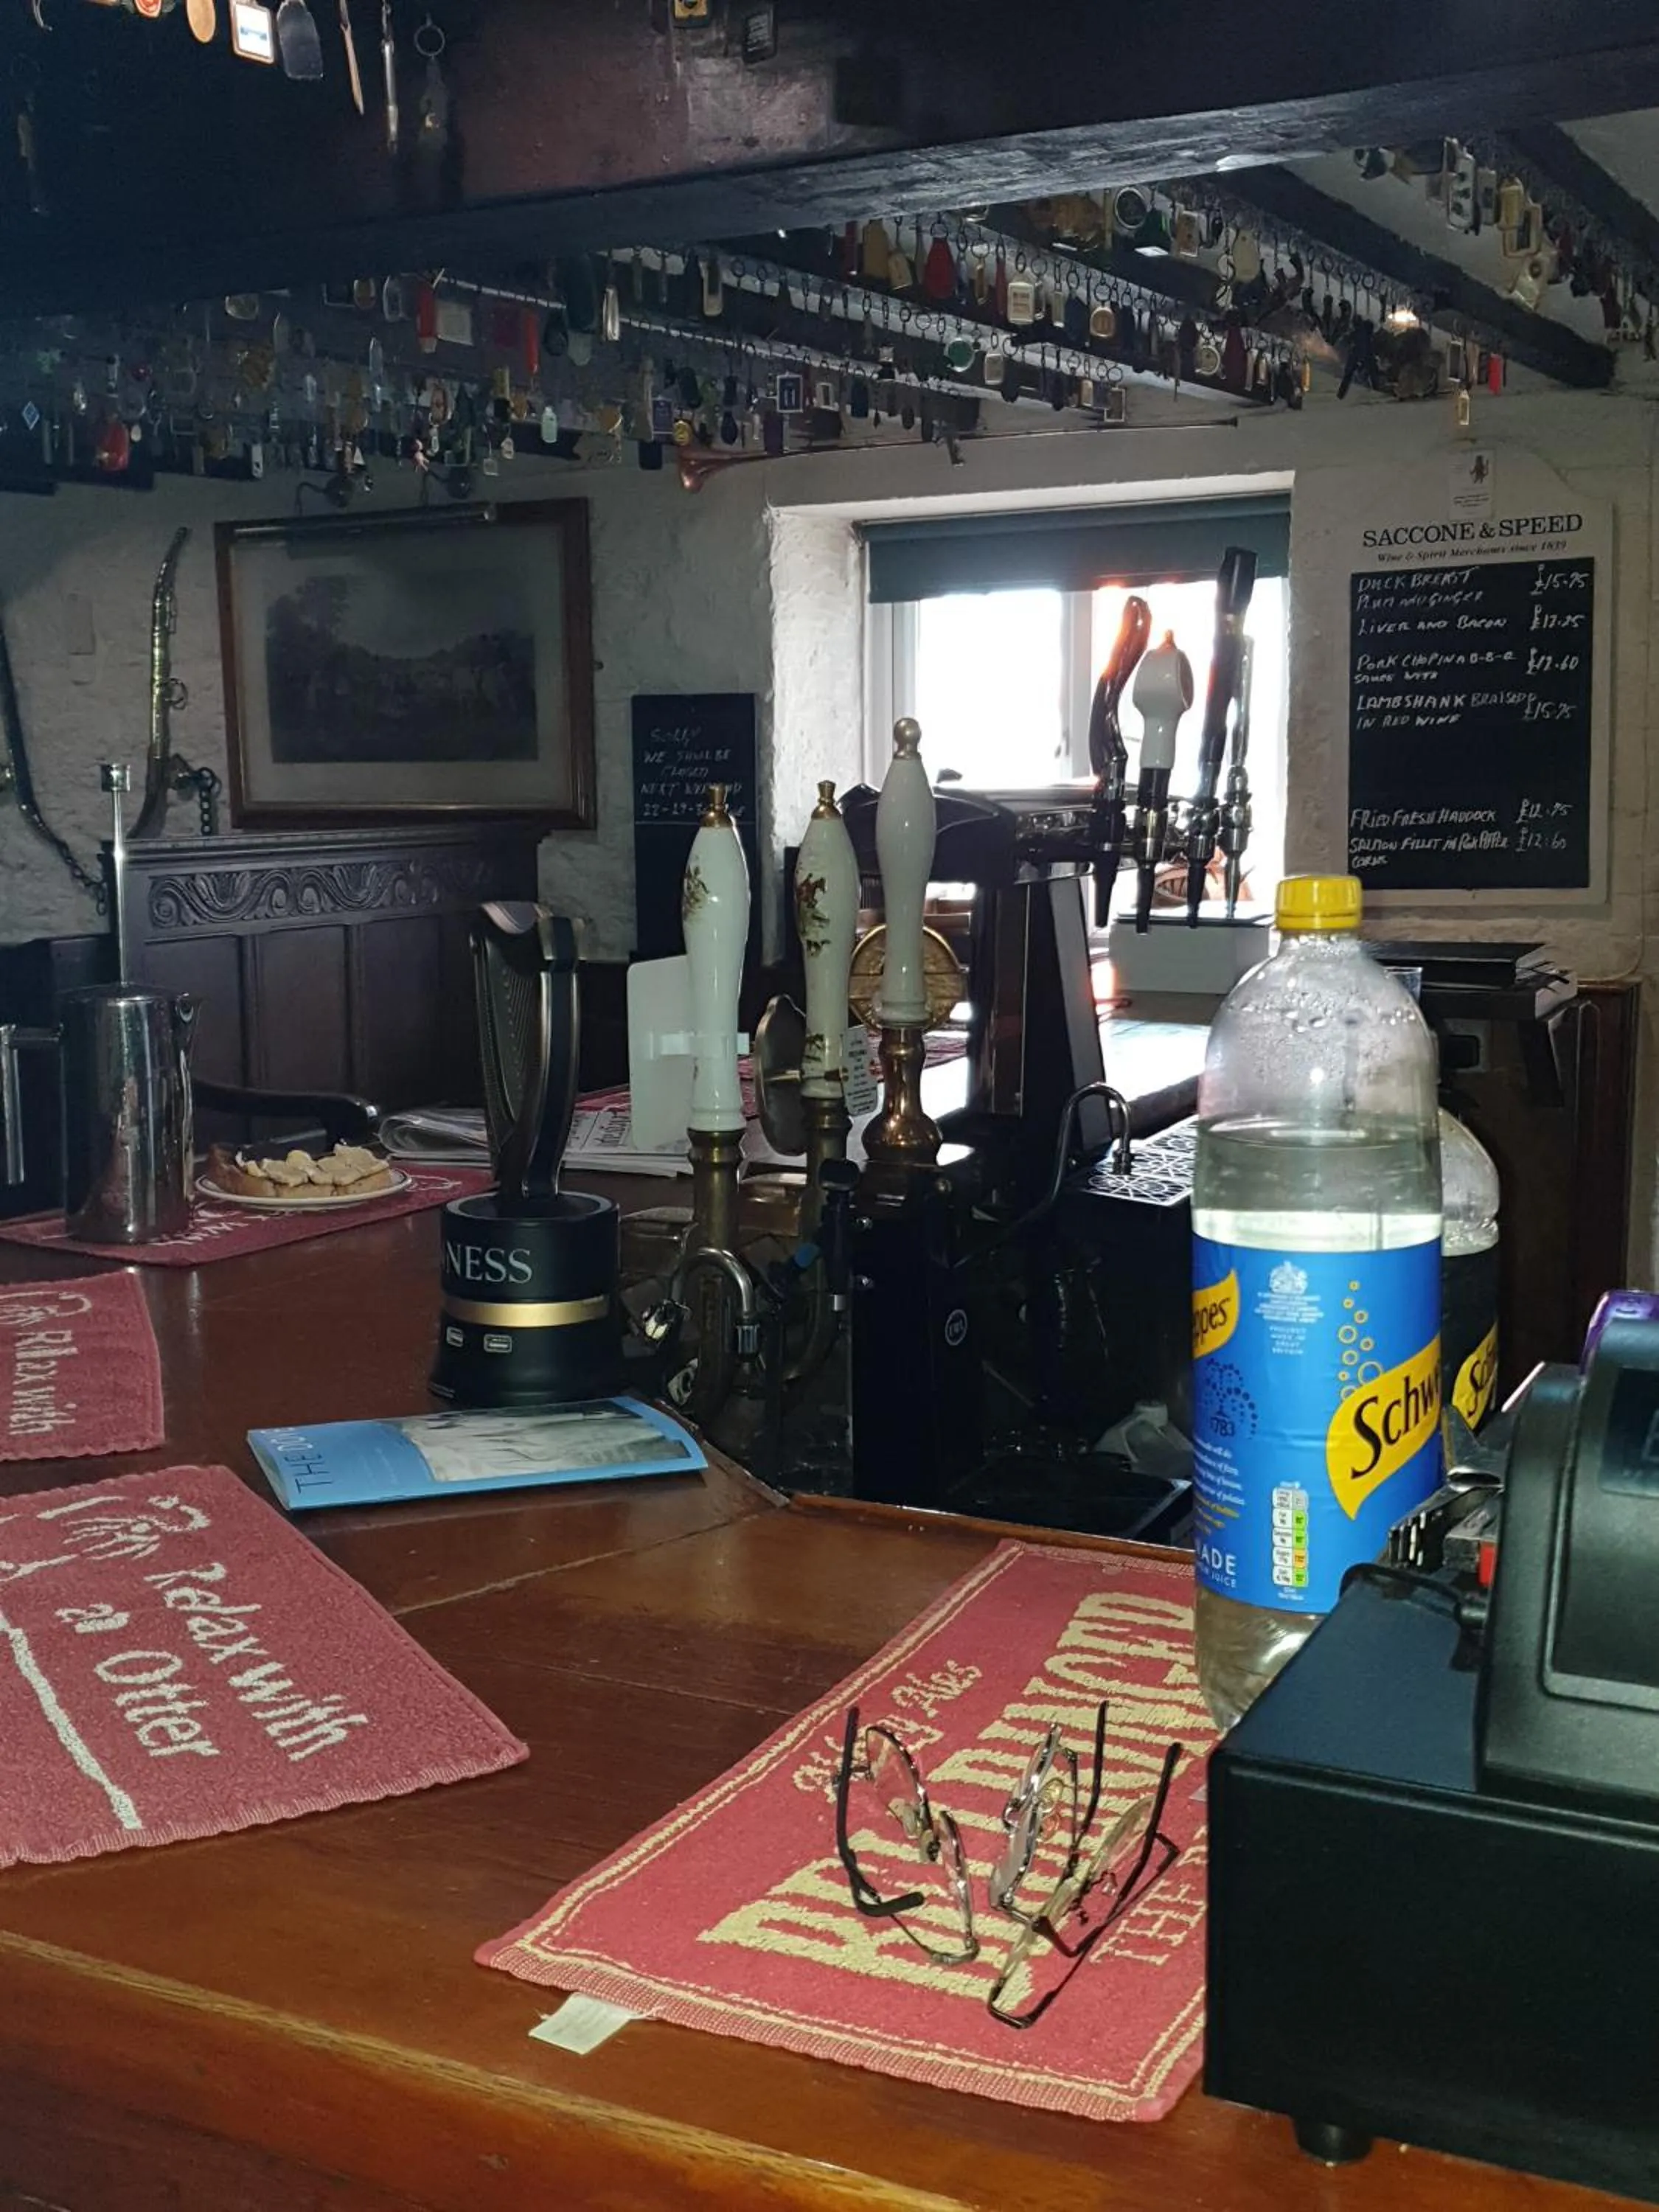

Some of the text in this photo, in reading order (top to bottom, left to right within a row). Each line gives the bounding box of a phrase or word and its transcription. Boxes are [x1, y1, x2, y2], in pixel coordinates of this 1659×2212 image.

[1363, 513, 1583, 547] SACCONE & SPEED
[446, 1239, 533, 1284] NESS
[9, 1386, 77, 1435] with
[284, 1454, 334, 1494] THE
[94, 1649, 220, 1757] Otter
[228, 1661, 369, 1761] with
[891, 1660, 983, 1718] Ales
[1089, 1879, 1208, 1965] THE
